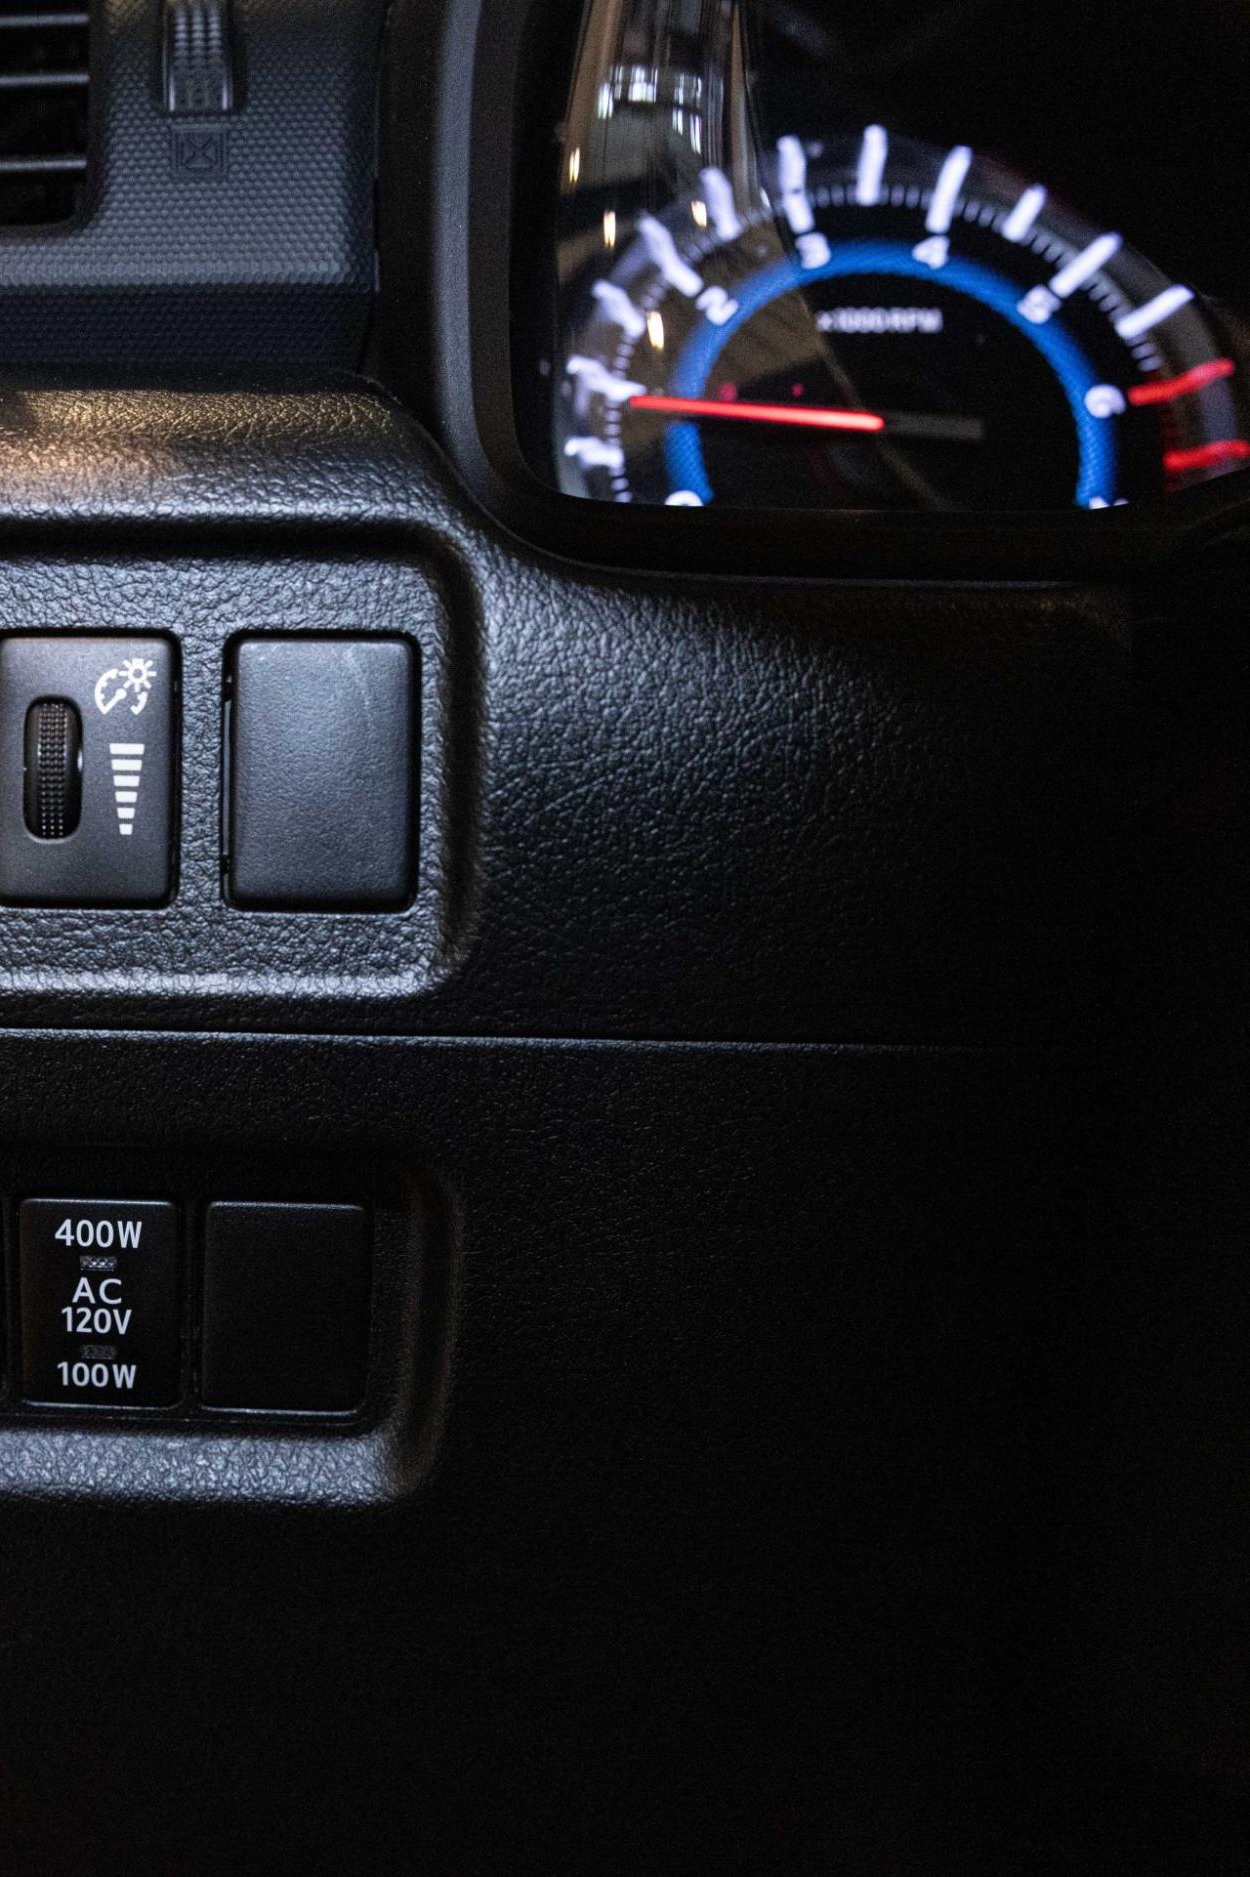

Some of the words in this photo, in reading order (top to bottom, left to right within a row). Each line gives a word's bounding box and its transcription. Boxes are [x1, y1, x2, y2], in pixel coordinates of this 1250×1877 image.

[53, 1218, 143, 1249] 400W
[71, 1276, 123, 1305] AC
[60, 1305, 133, 1336] 120V
[56, 1360, 138, 1390] 100W
